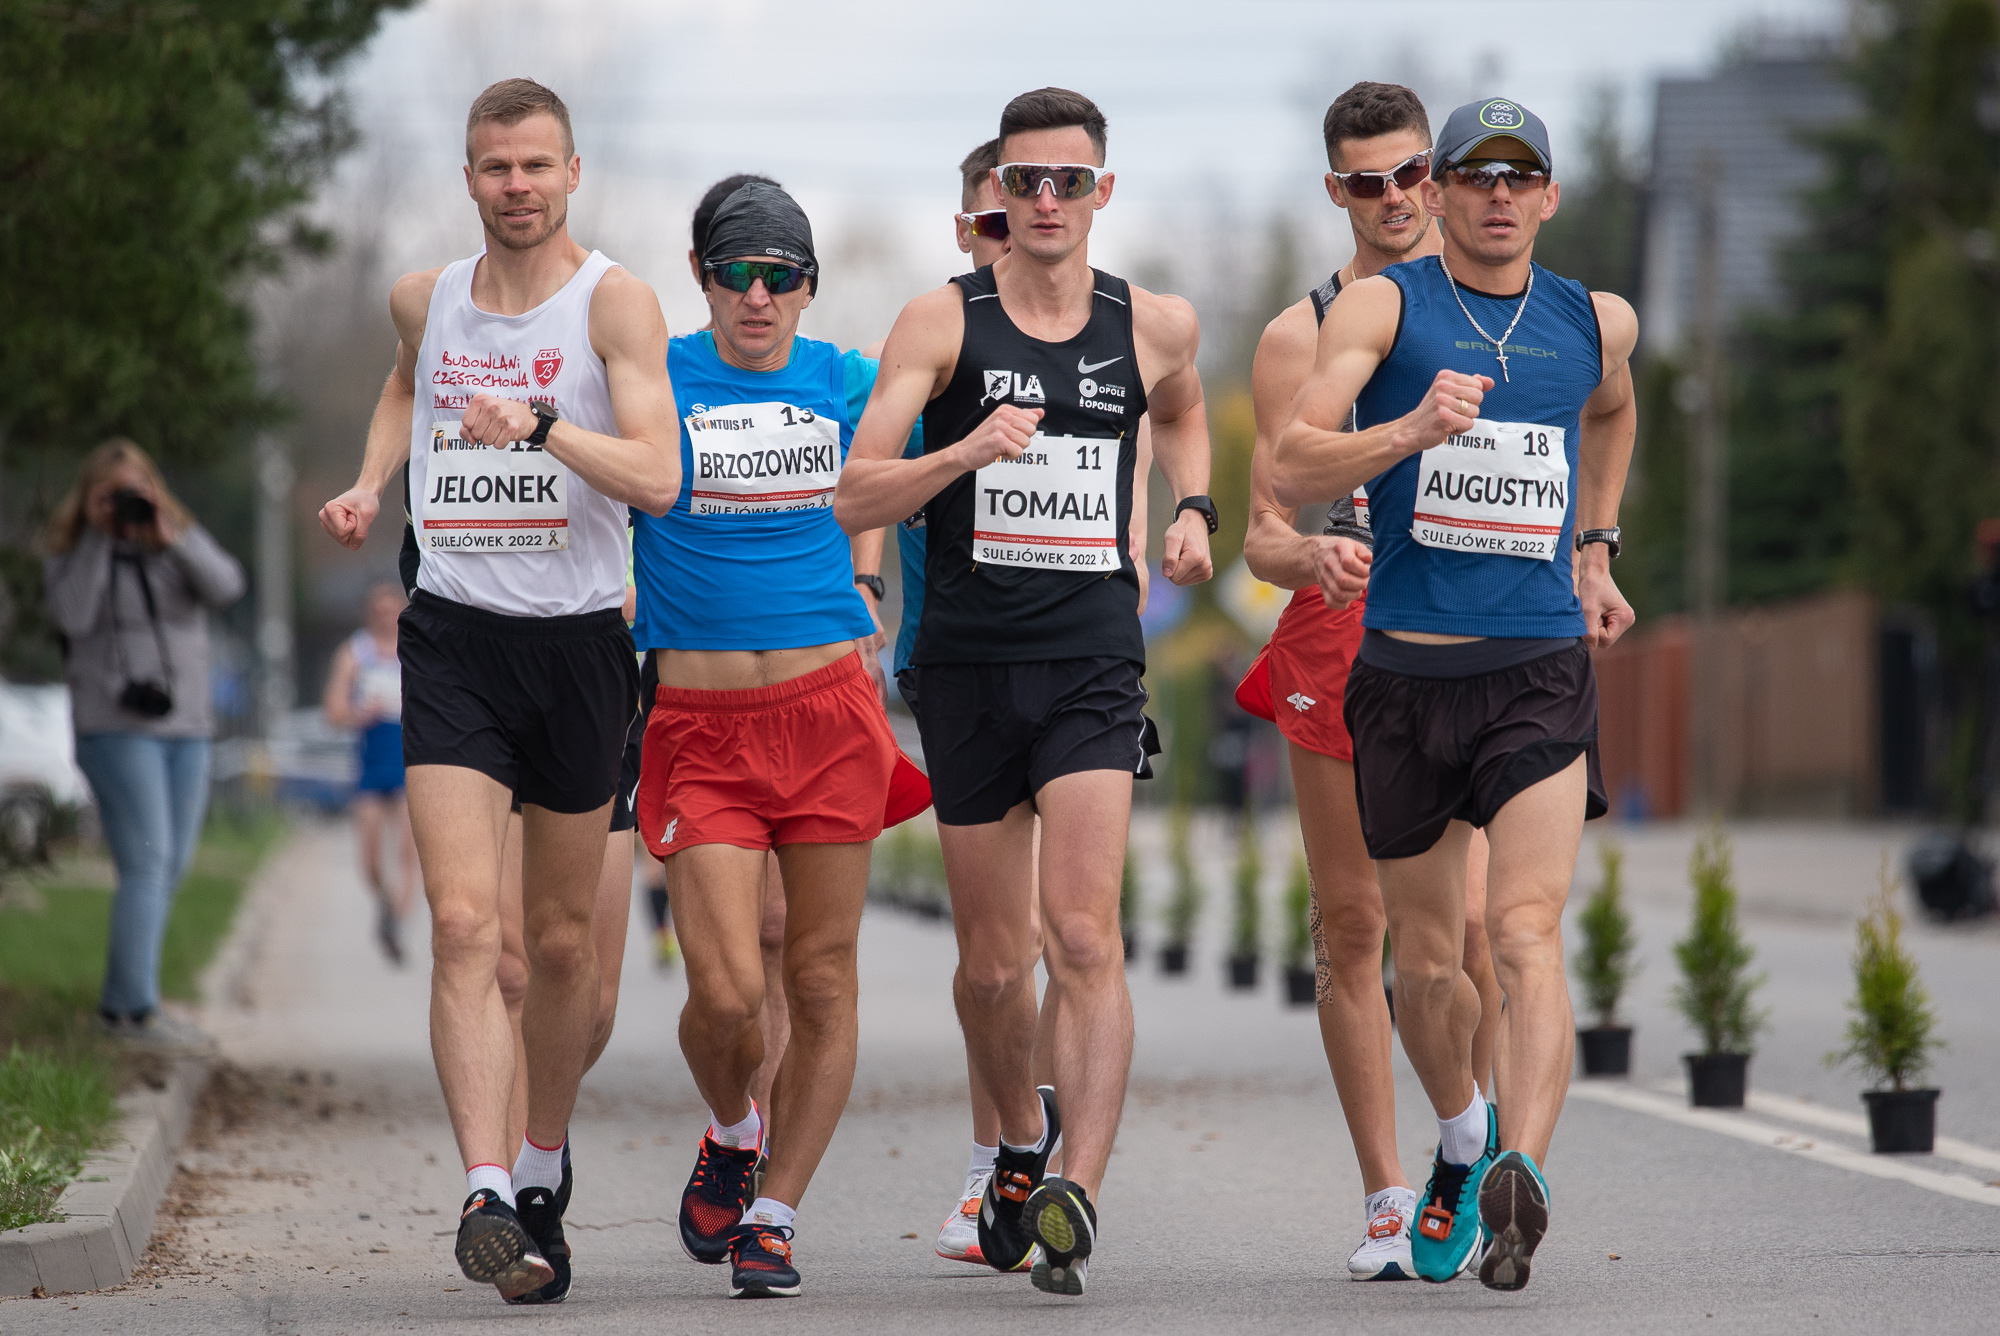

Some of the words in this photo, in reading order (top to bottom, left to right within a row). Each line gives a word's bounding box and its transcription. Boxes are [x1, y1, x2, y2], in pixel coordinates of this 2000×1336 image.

[540, 351, 557, 359] CKS
[1098, 386, 1126, 398] OPOLE
[780, 406, 816, 427] 13
[1085, 399, 1125, 415] OPOLSKIE
[1523, 431, 1550, 457] 18
[700, 444, 834, 480] BRZOZOWSKI
[1076, 445, 1102, 470] 11
[430, 474, 559, 504] JELONEK
[1423, 469, 1565, 509] AUGUSTYN
[984, 488, 1110, 522] TOMALA
[431, 532, 504, 547] SULEJÓWEK
[508, 535, 542, 547] 2022
[1421, 529, 1506, 551] SULEJÓWEK
[1510, 540, 1545, 553] 2022
[982, 547, 1065, 565] SULEJÓWEK
[1069, 553, 1097, 565] 2022
